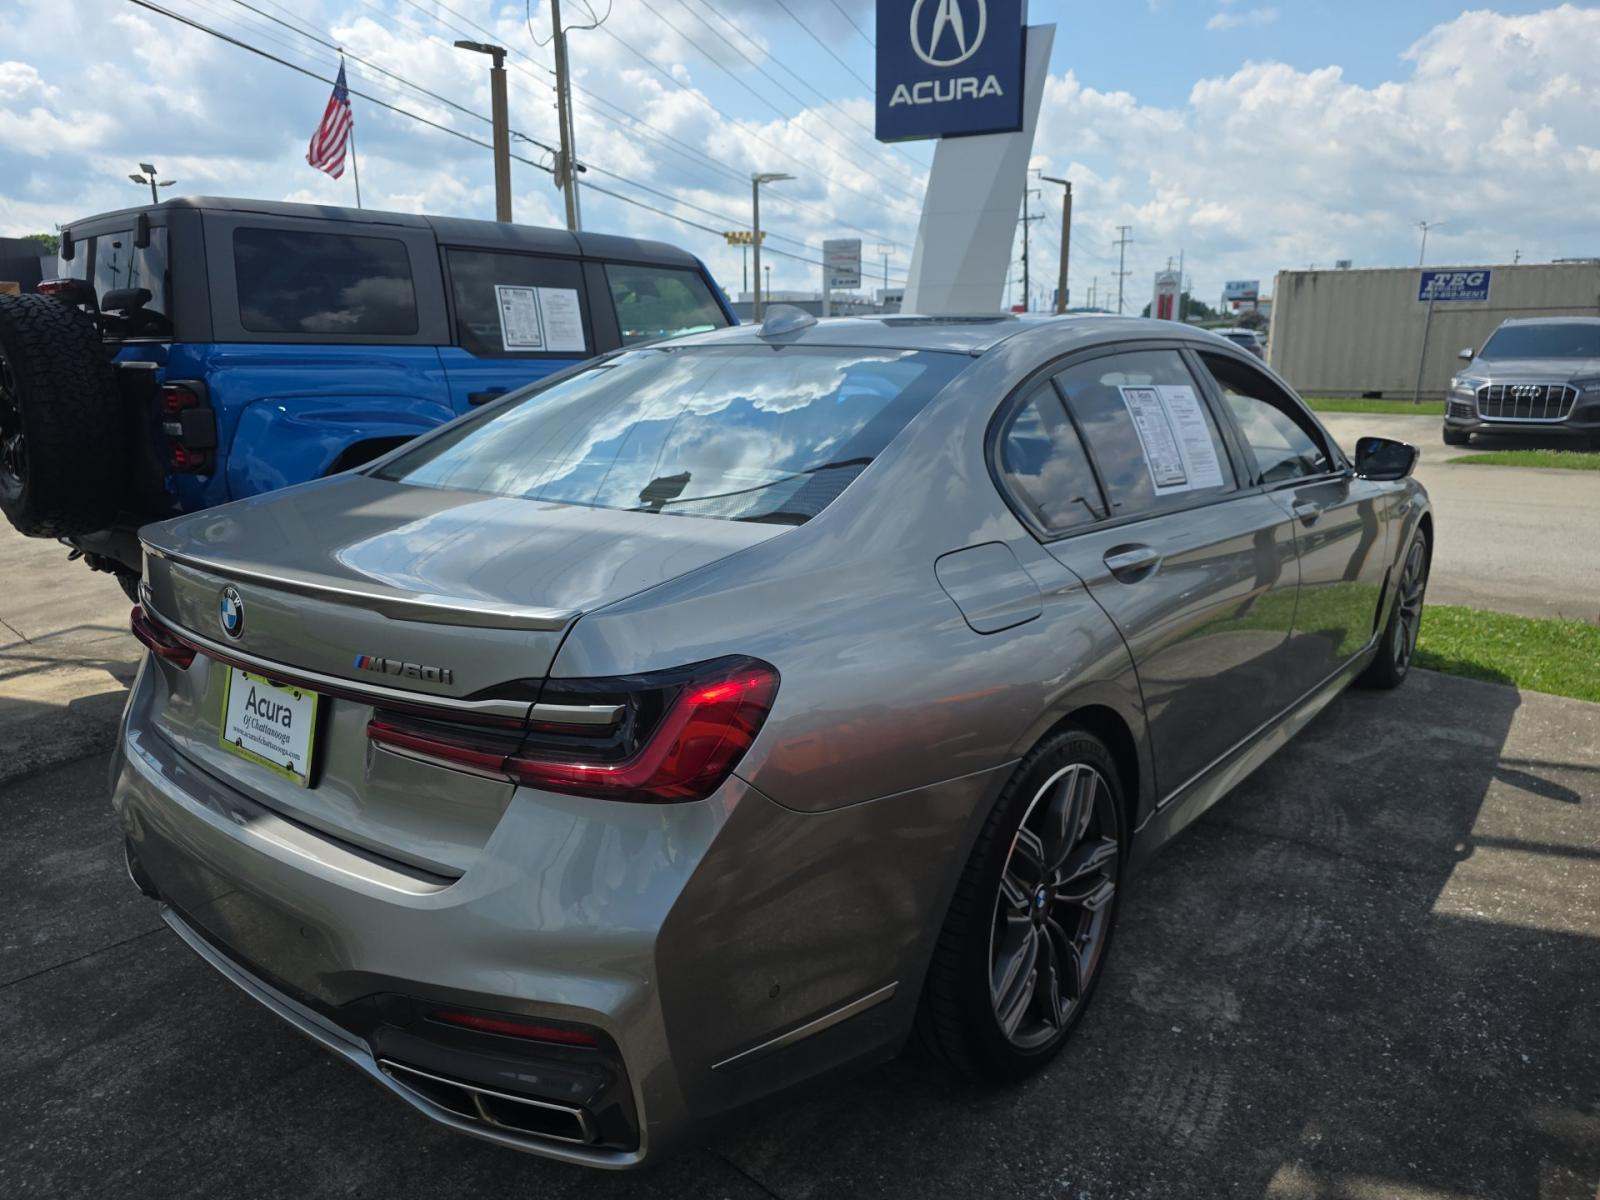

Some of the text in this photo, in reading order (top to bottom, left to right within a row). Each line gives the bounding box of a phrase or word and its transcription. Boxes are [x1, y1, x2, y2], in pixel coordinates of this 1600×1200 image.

[888, 74, 1004, 107] ACURA
[360, 655, 453, 685] M760i
[245, 685, 292, 729] Acura
[243, 714, 291, 746] Of Chattanooga
